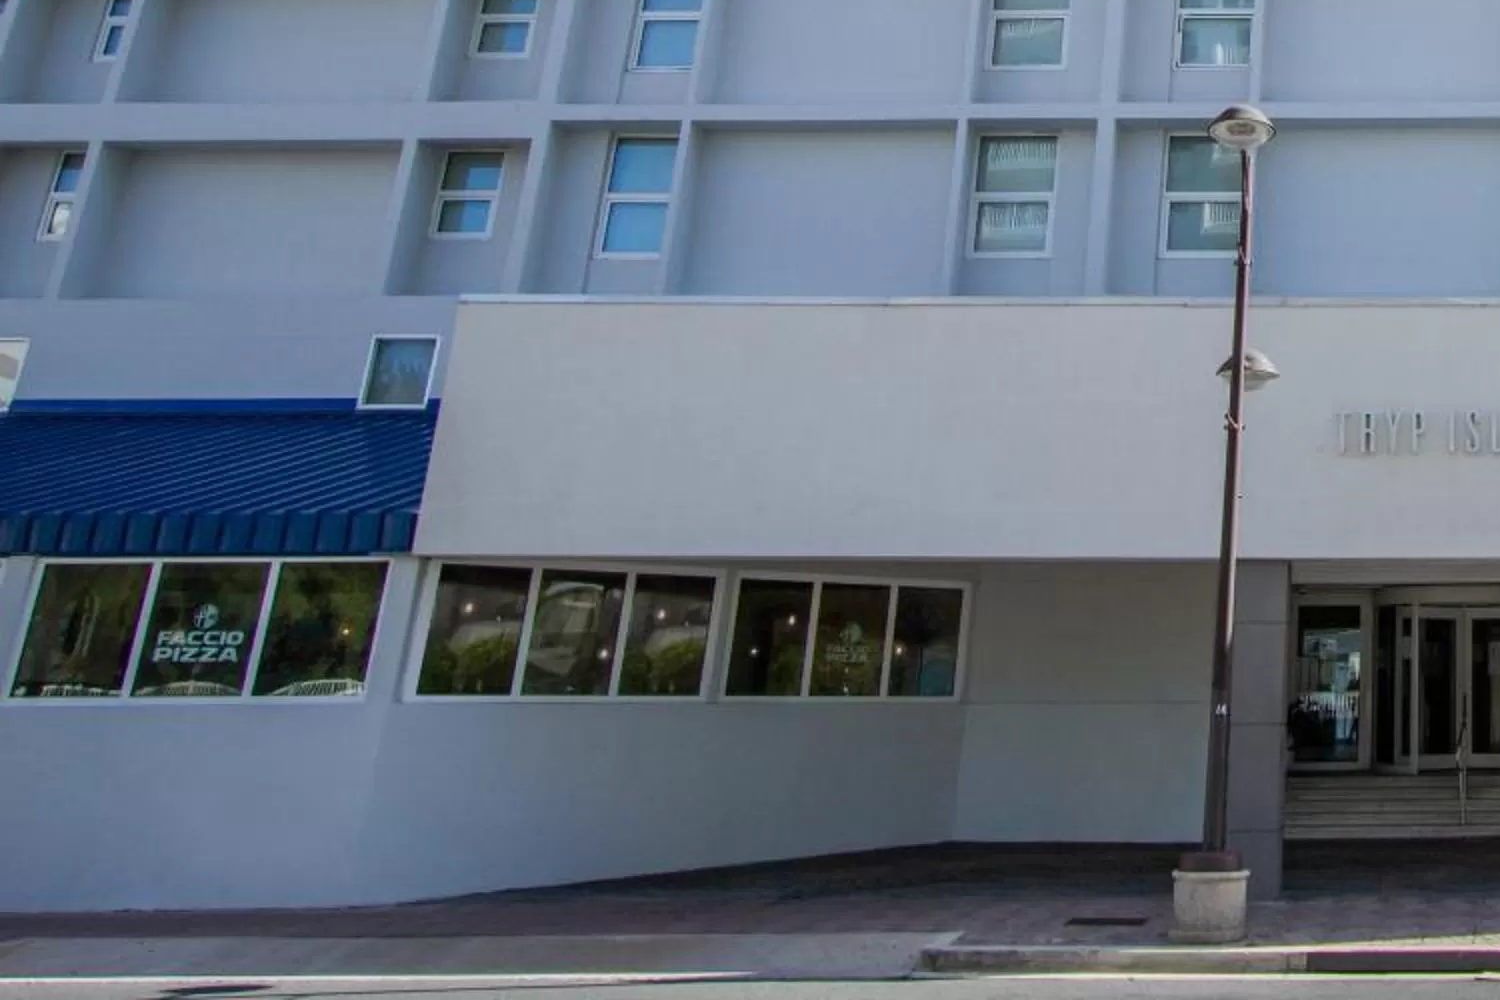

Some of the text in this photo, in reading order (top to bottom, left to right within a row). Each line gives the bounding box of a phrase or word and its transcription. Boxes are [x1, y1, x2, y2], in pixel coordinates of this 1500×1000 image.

[1335, 410, 1425, 456] TRYP
[157, 630, 245, 646] FACCIO
[152, 646, 238, 663] PIZZA
